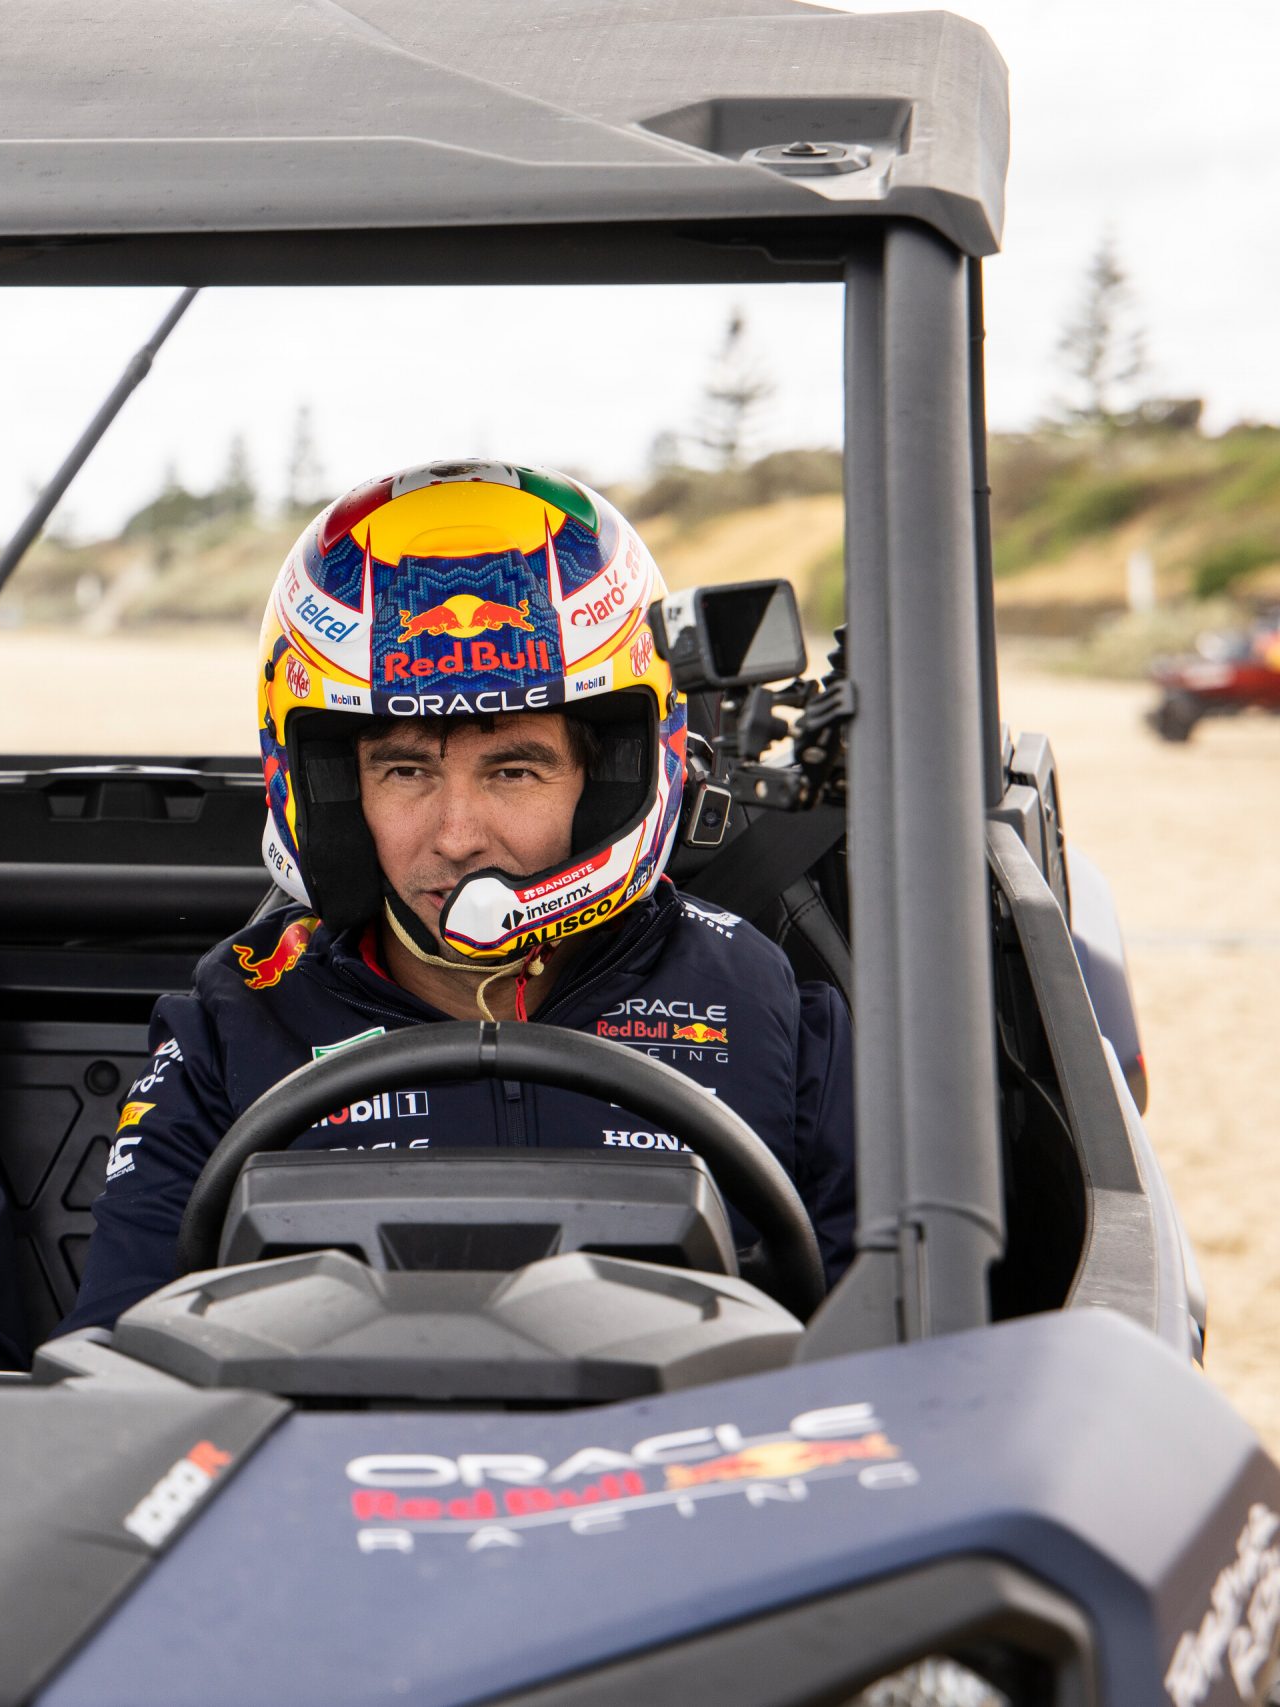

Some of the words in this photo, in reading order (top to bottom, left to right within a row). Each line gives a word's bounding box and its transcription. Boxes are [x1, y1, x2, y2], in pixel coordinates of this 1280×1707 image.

[295, 594, 360, 643] telcel
[384, 641, 464, 682] Red
[471, 640, 551, 671] Bull
[287, 661, 310, 696] KitKat
[576, 677, 598, 692] Mobil
[331, 693, 352, 705] Mobil
[387, 686, 550, 716] ORACLE
[268, 842, 293, 879] BYBIT
[535, 863, 595, 896] BANORTE
[625, 860, 656, 900] BYBIT
[526, 883, 593, 920] inter.mx
[511, 899, 612, 950] JALISCO
[596, 1019, 631, 1037] Red
[634, 1021, 668, 1039] Bull
[647, 1048, 728, 1064] CING
[602, 1129, 694, 1153] HON
